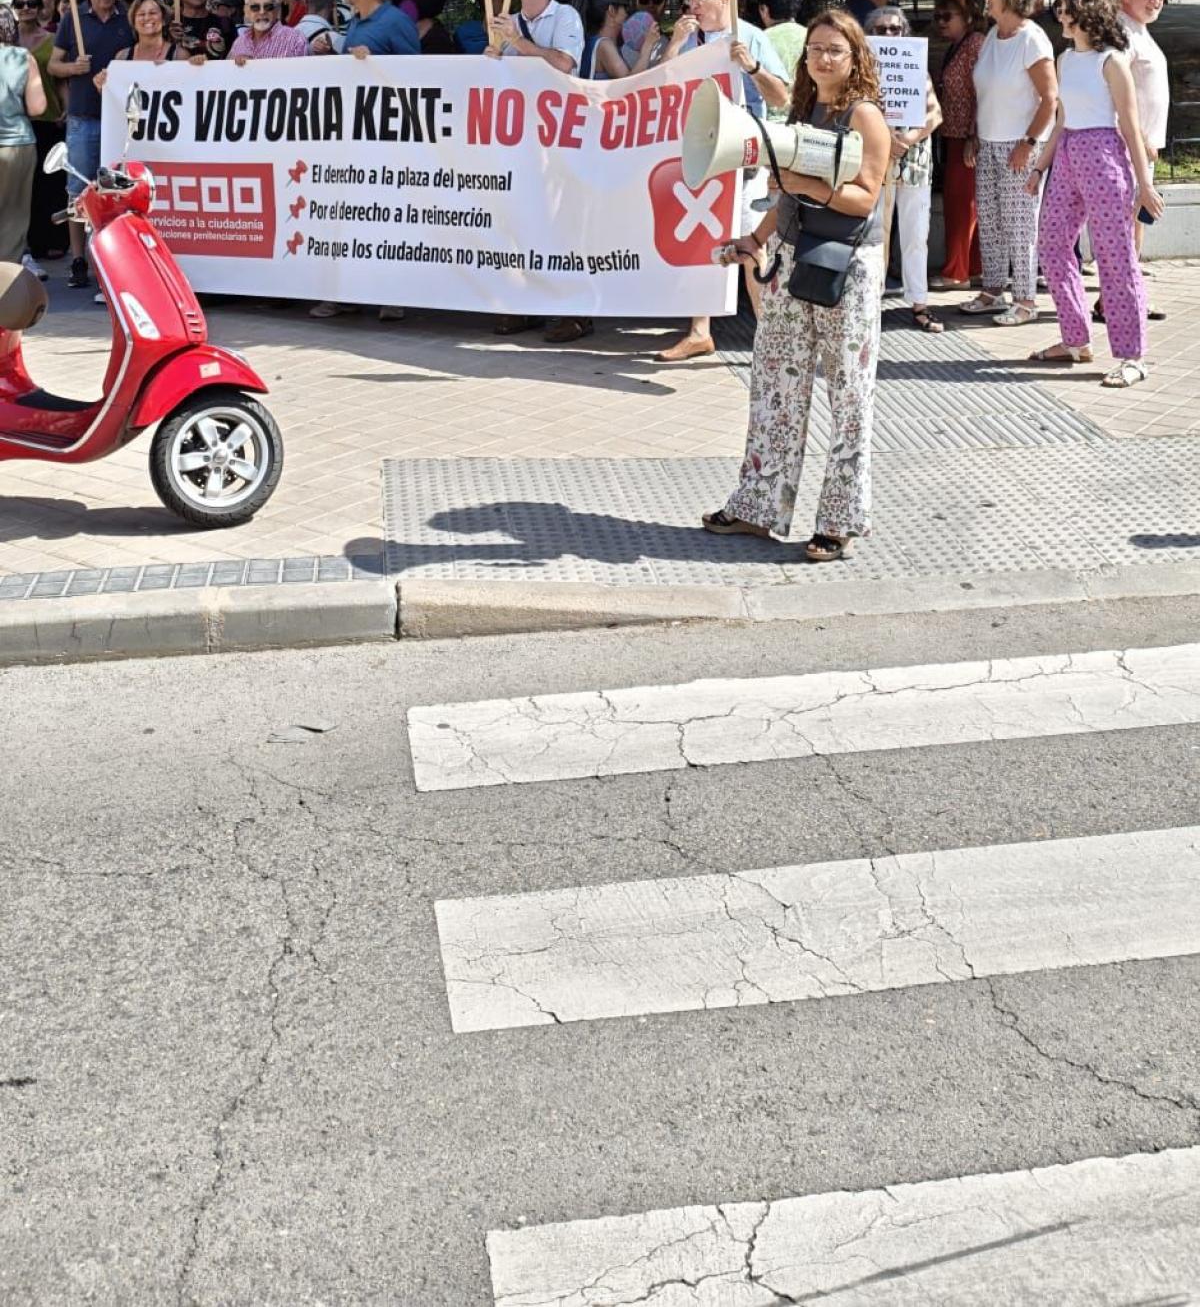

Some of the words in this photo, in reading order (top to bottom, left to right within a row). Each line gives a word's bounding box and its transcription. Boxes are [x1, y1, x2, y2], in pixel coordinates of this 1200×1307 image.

[879, 46, 898, 56] NO
[886, 74, 904, 82] CIS
[880, 87, 920, 96] CTORIA
[194, 86, 343, 142] VICTORIA
[352, 86, 453, 143] KENT:
[467, 87, 526, 146] NO
[536, 89, 589, 149] SE
[312, 164, 322, 183] El
[324, 164, 365, 184] derecho
[368, 169, 377, 184] a
[381, 165, 394, 185] la
[397, 166, 430, 188] plaza
[433, 167, 454, 188] del
[457, 170, 513, 192] personal
[309, 200, 328, 220] Por
[329, 200, 338, 220] el
[339, 200, 390, 222] derecho
[394, 207, 402, 223] a
[406, 204, 418, 224] la
[422, 205, 492, 228] reinserción
[149, 215, 187, 227] ervicios
[197, 217, 206, 228] la
[207, 217, 264, 230] ciudadanía
[193, 231, 247, 241] penitenciarias
[307, 236, 329, 256] Para
[331, 241, 348, 260] que
[352, 238, 372, 259] los
[376, 240, 453, 264] ciudadanos
[456, 247, 473, 265] no
[477, 249, 525, 270] paguen
[529, 249, 543, 270] la
[547, 250, 584, 272] mala
[587, 249, 640, 275] gestión
